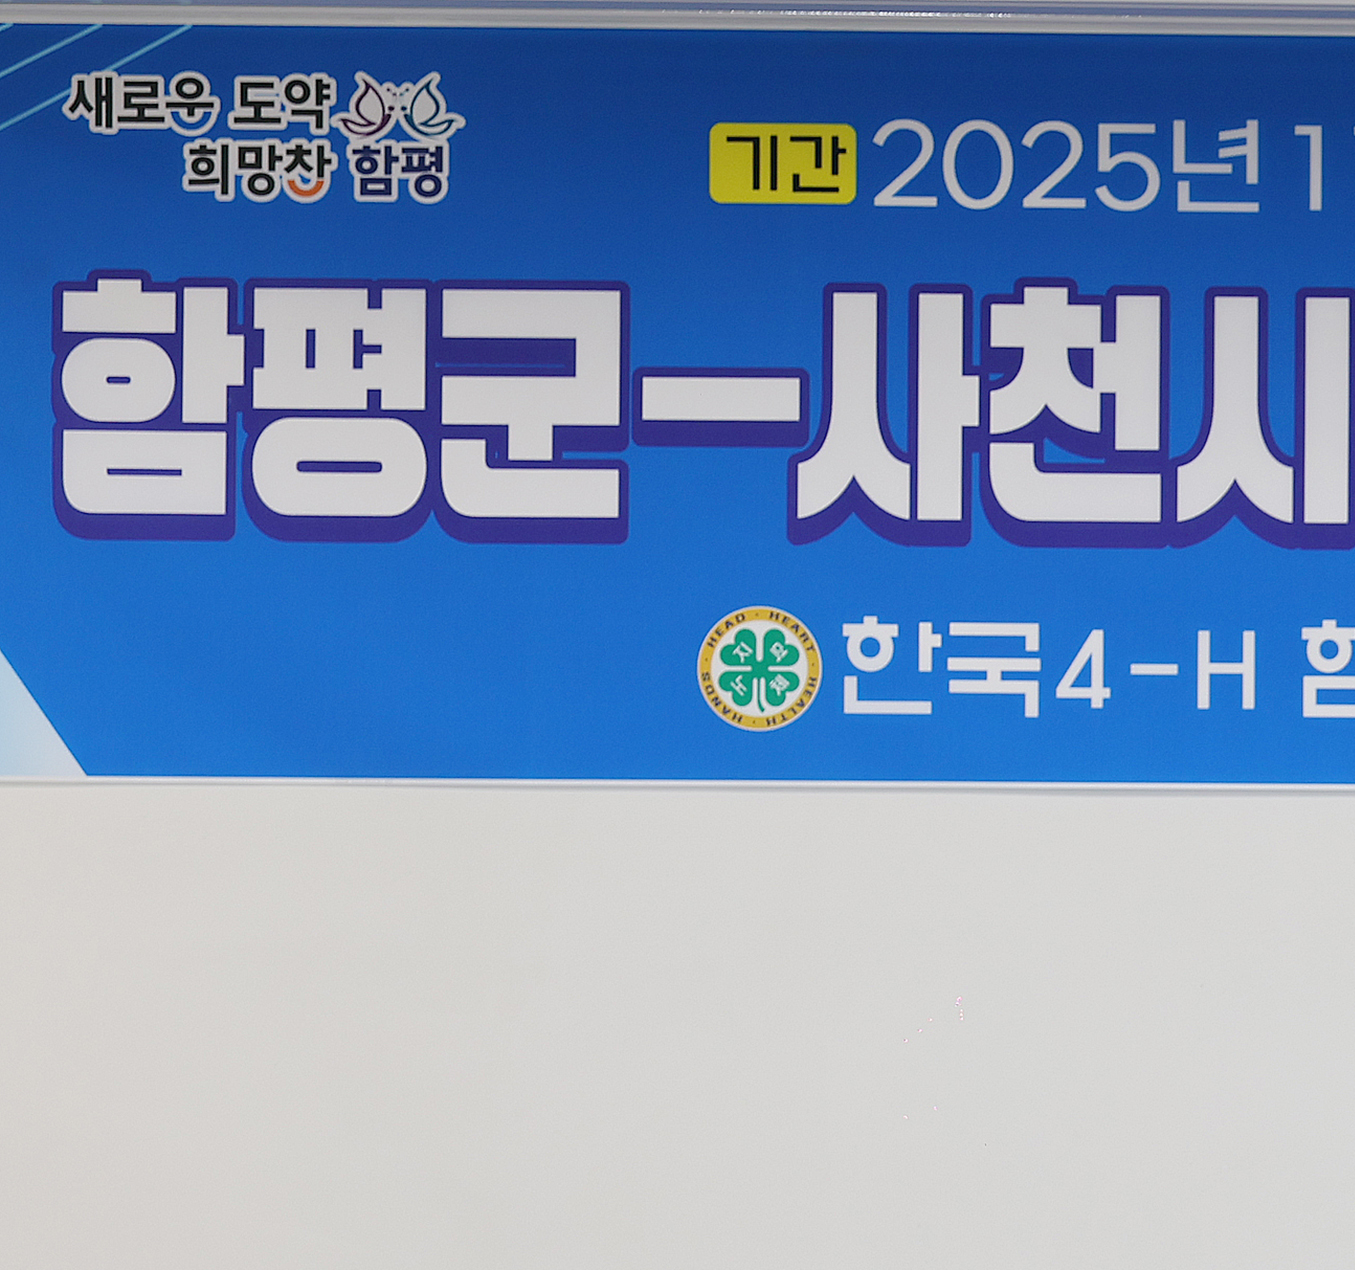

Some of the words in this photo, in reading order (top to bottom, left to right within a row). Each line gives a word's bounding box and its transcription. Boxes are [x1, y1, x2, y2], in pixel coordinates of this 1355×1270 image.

[69, 76, 215, 131] 새로운
[234, 77, 331, 129] 도약
[188, 143, 331, 196] 희망찬
[352, 145, 443, 196] 함평
[725, 135, 845, 195] 기간
[875, 118, 1261, 213] 2025년
[707, 612, 746, 648] HEAD
[769, 611, 815, 652] HEART
[701, 672, 743, 723] HANDS
[766, 677, 817, 726] HEALTH
